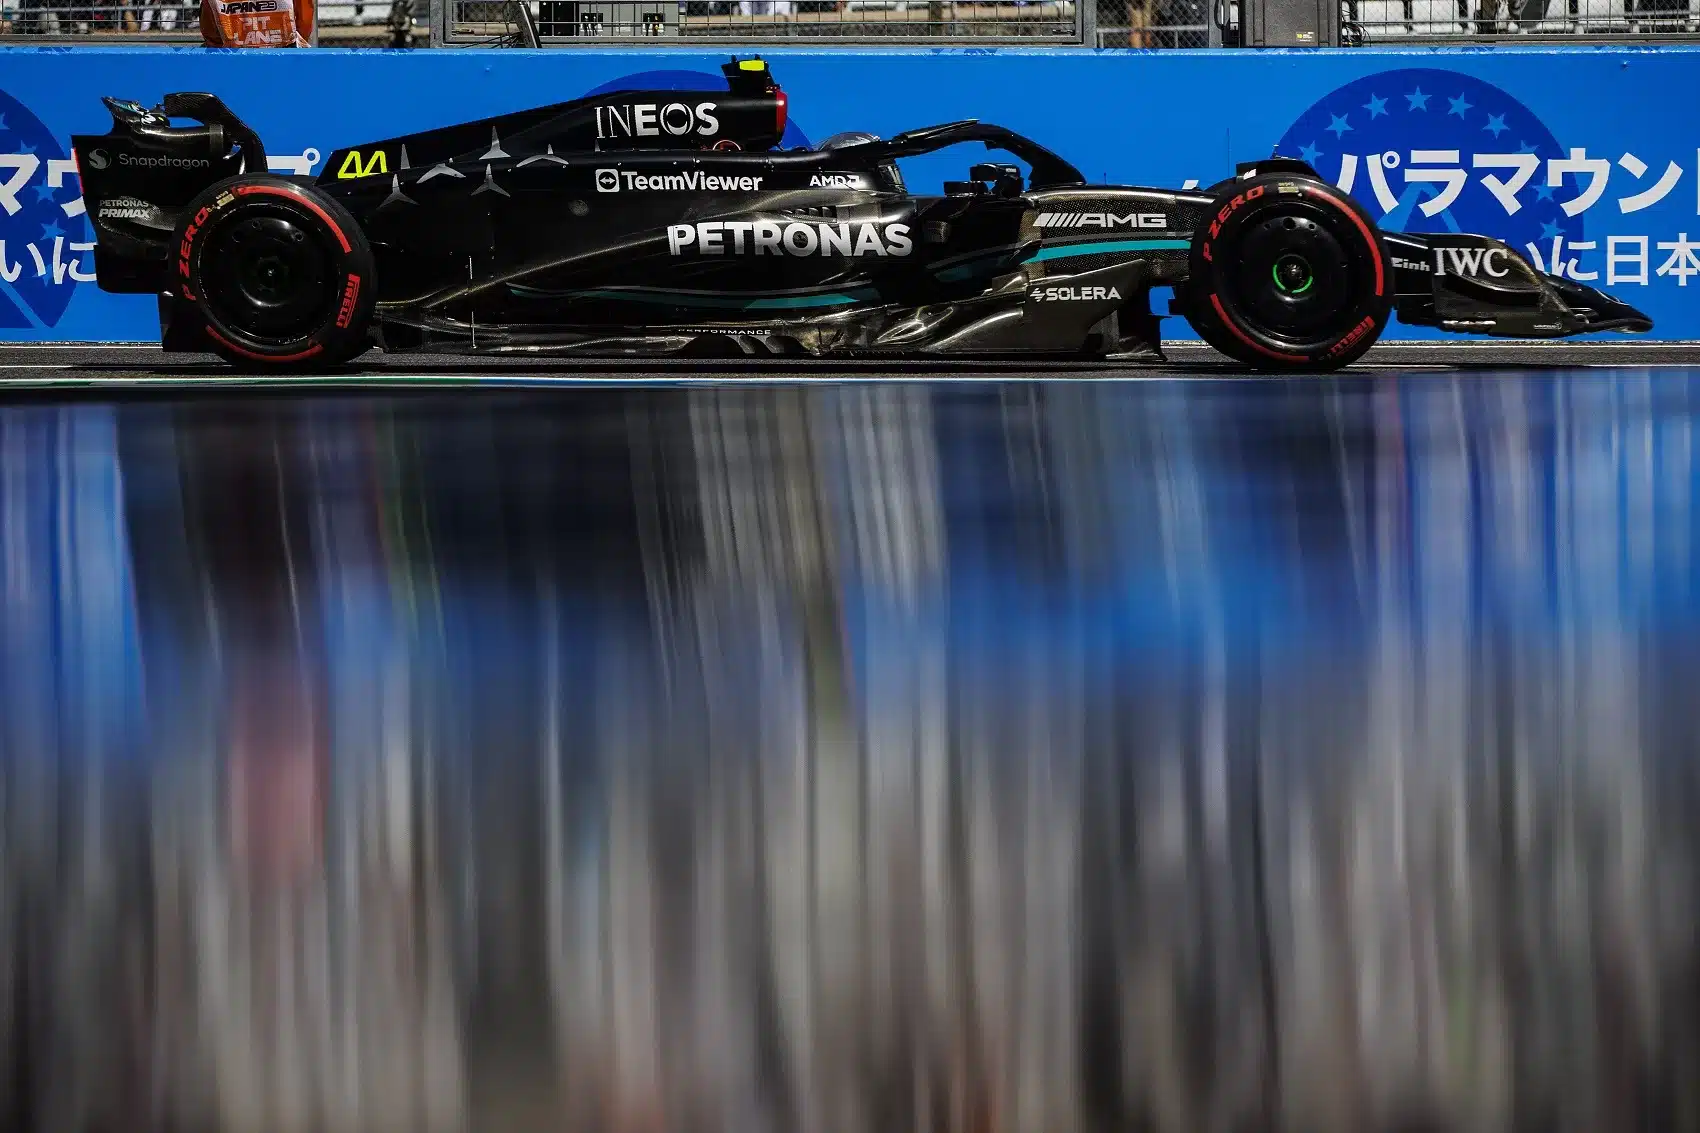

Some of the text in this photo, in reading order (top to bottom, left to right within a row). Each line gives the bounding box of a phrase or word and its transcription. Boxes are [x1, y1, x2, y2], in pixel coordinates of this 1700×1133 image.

[234, 30, 282, 45] LANE
[594, 103, 719, 138] INEOS
[119, 153, 209, 170] Snapdragon
[337, 150, 388, 179] 44
[621, 171, 763, 191] TeamViewer
[809, 175, 847, 187] AMD
[1337, 148, 1700, 217] パラマウン
[98, 208, 151, 219] PRIMAX
[99, 199, 149, 208] PETRONAS
[1208, 185, 1265, 240] ZERO
[1075, 213, 1167, 228] AMG
[179, 206, 209, 279] ZERO
[667, 222, 913, 257] PETRONAS
[1433, 247, 1510, 278] IWC
[336, 273, 361, 329] PIRELLI
[1045, 286, 1122, 301] SOLERA
